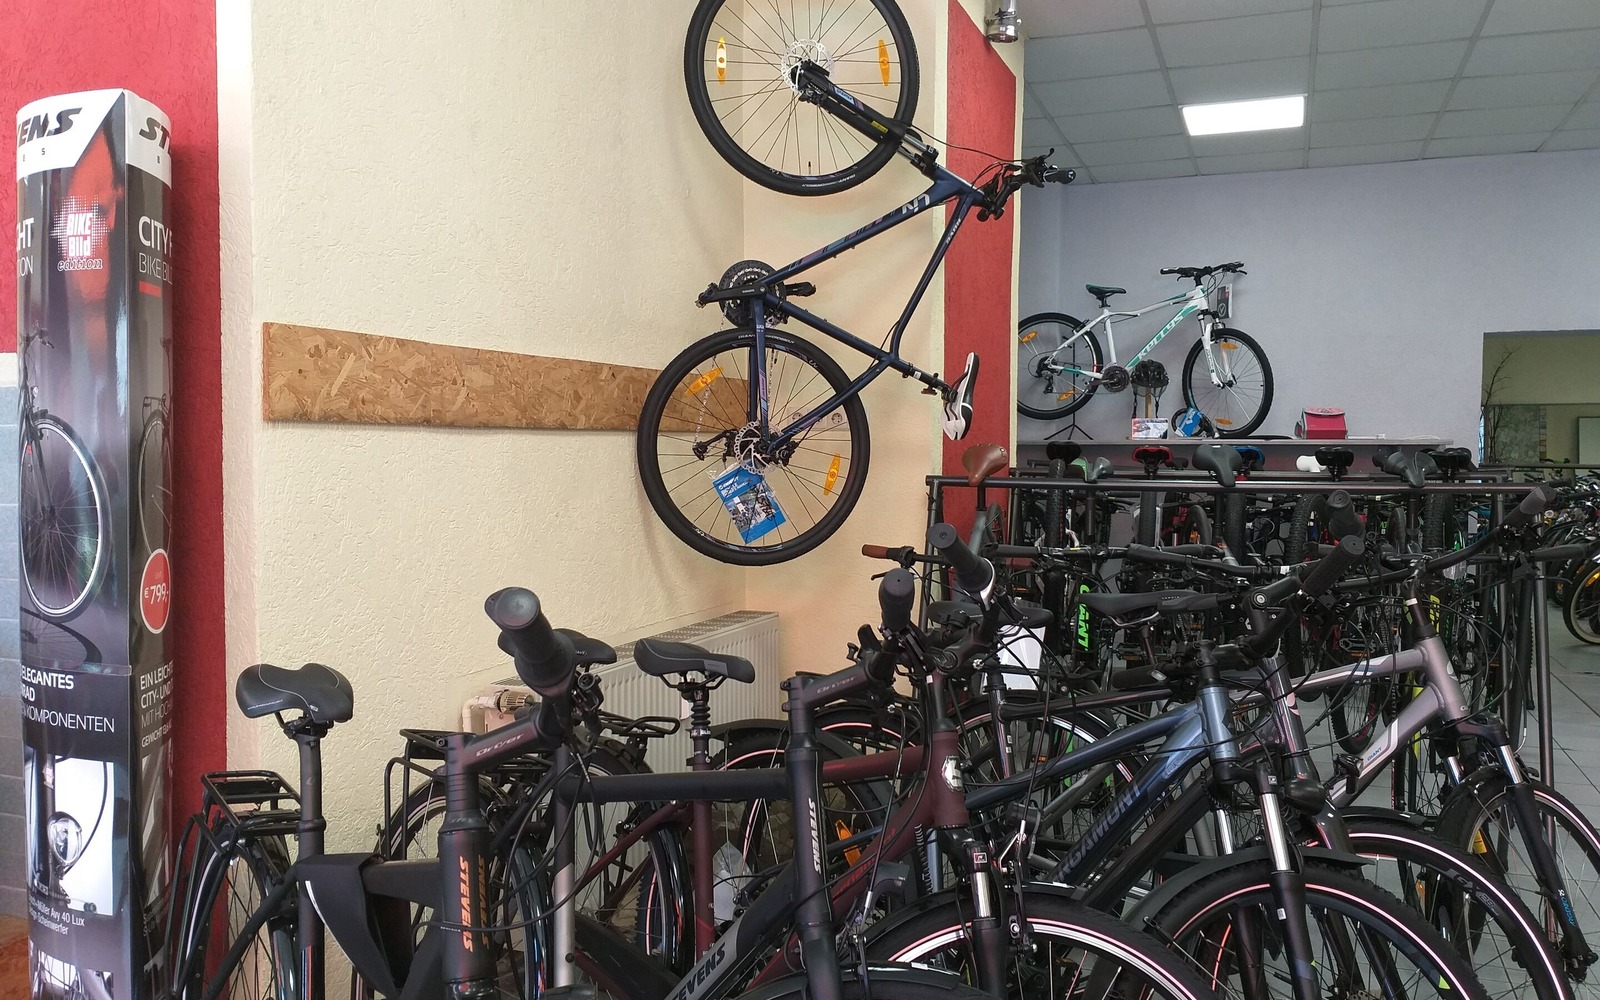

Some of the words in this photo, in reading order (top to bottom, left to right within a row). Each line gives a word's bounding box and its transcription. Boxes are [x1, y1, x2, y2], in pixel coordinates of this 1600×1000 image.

[18, 107, 83, 148] ENS
[139, 117, 171, 156] ST
[17, 217, 35, 252] HT
[66, 212, 94, 236] BIKE
[139, 215, 169, 255] CITY
[57, 255, 103, 272] edition
[139, 251, 162, 279] BIKE
[144, 587, 149, 599] €
[140, 671, 154, 690] EIN
[140, 688, 160, 709] CITY-
[27, 705, 115, 733] KOMPONENTEN
[808, 797, 822, 876] STEVENS
[61, 912, 70, 923] 40
[71, 914, 85, 927] Lux
